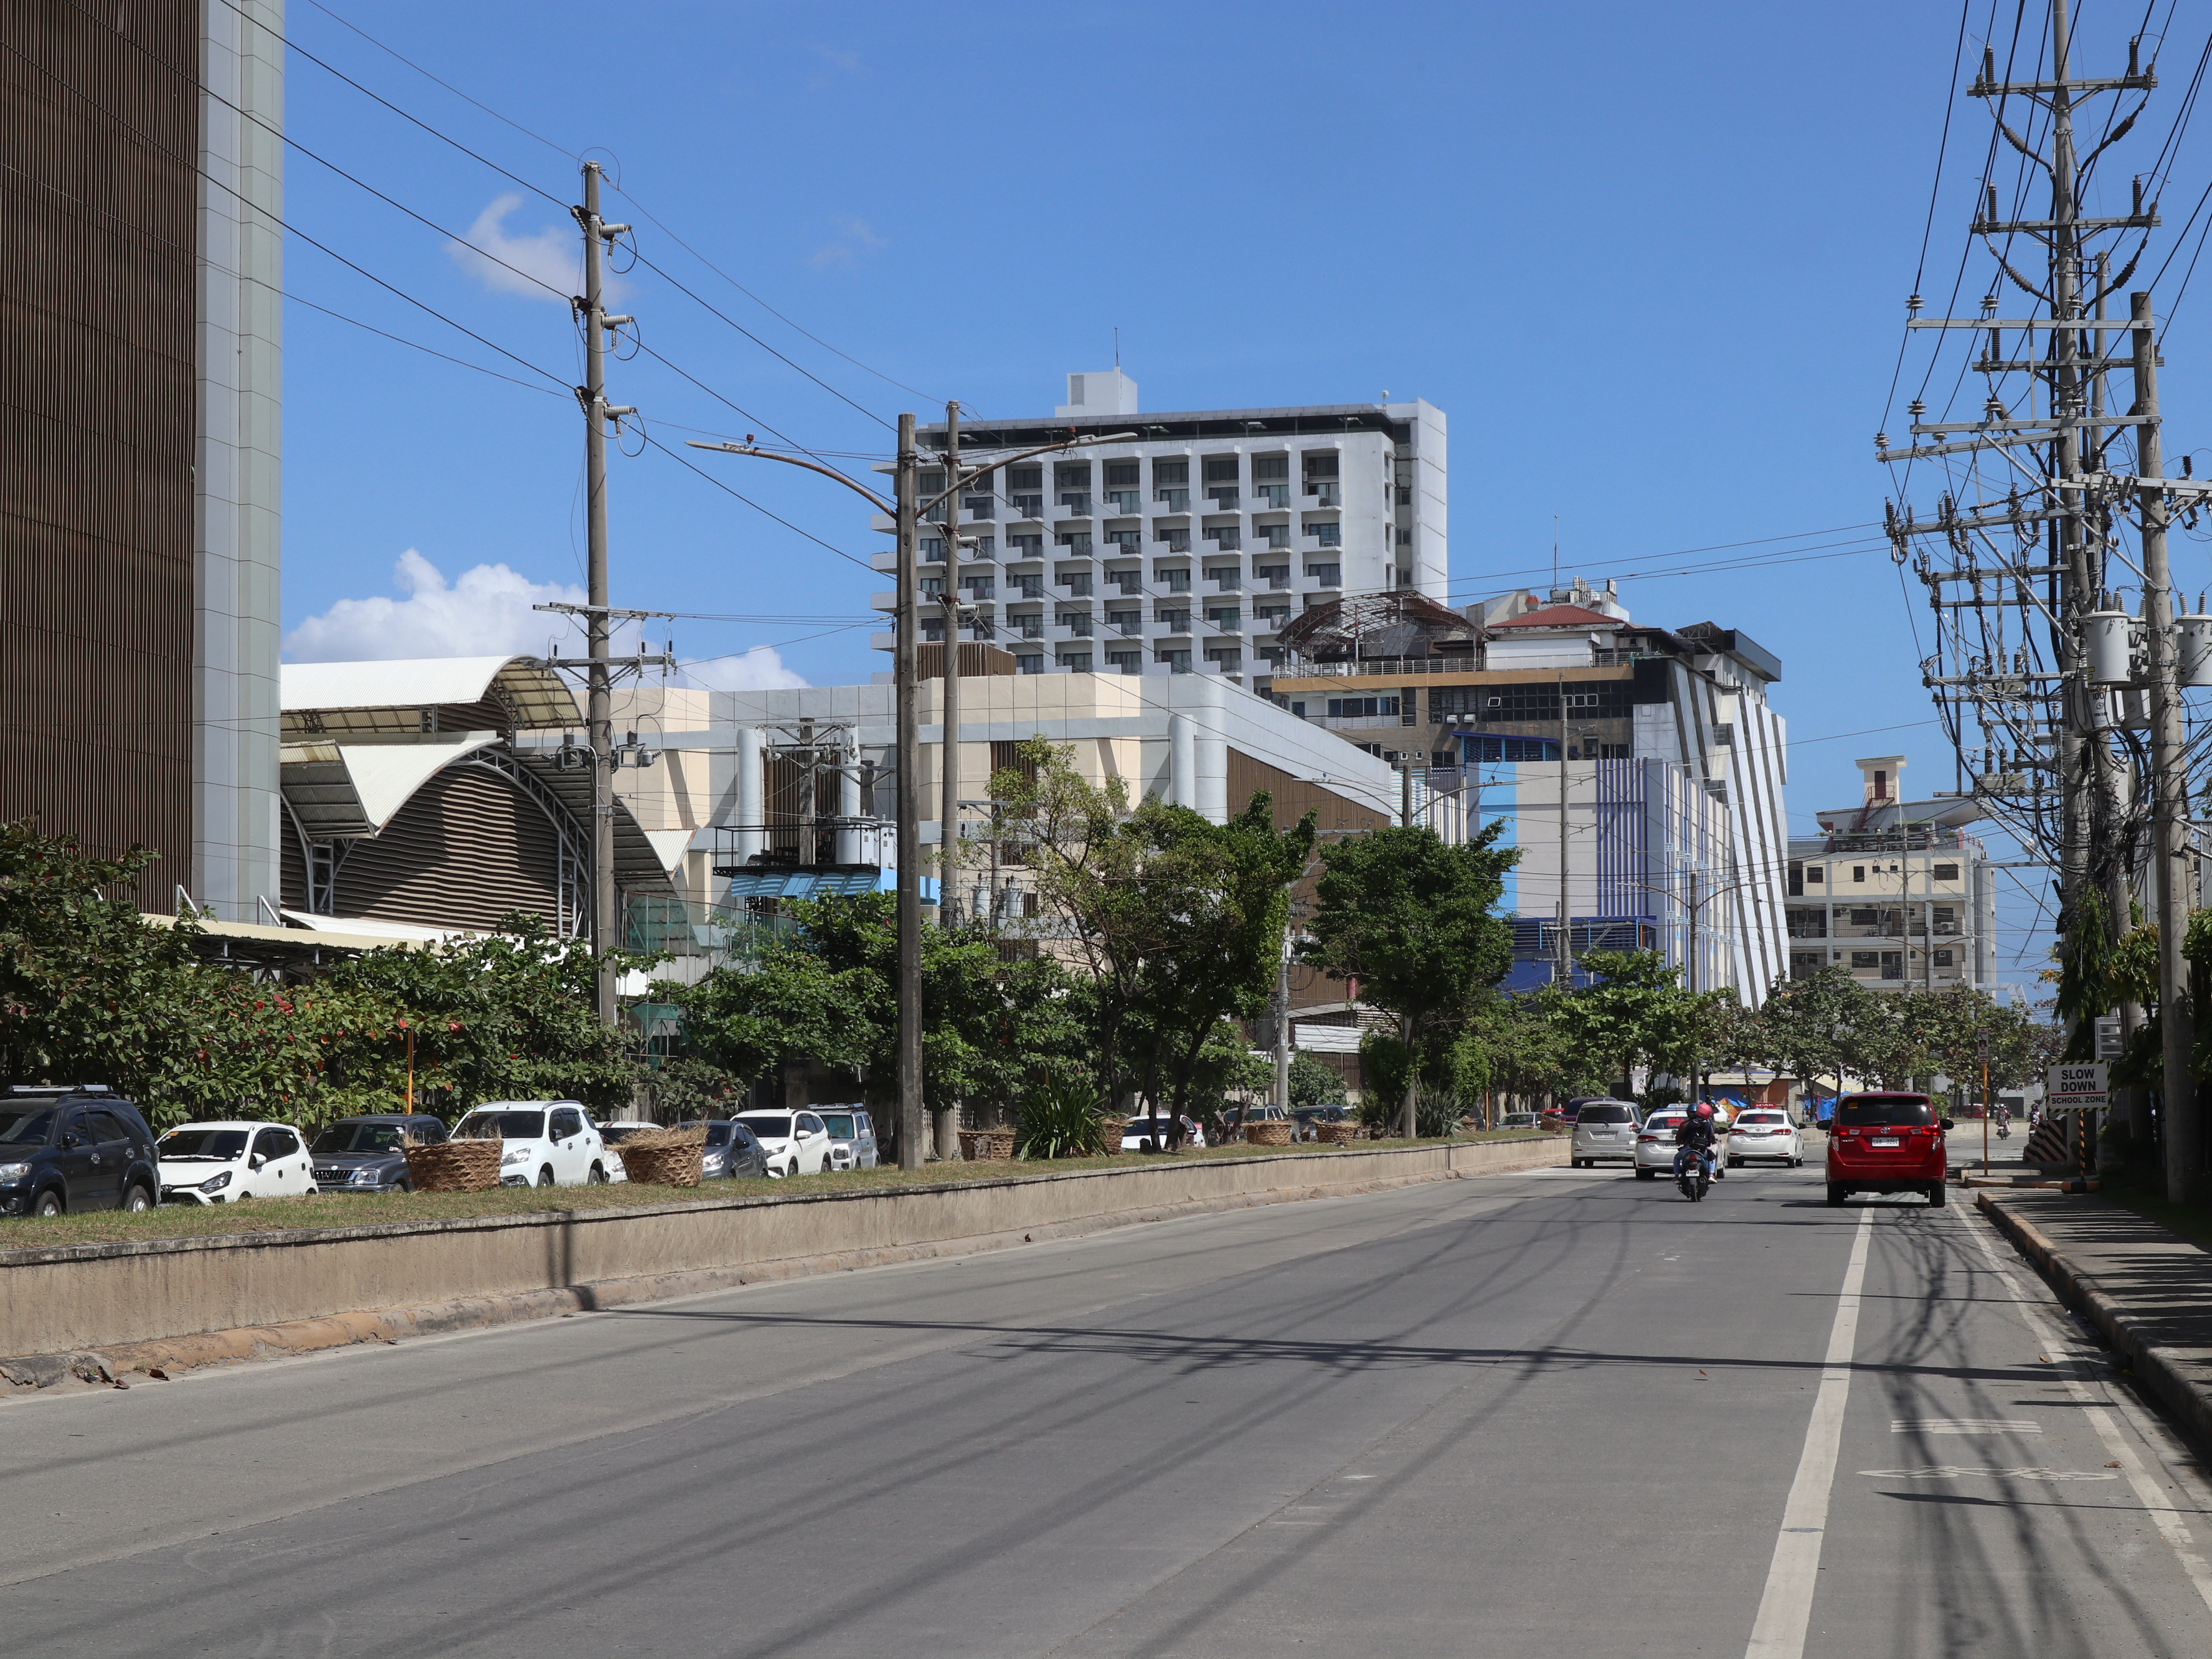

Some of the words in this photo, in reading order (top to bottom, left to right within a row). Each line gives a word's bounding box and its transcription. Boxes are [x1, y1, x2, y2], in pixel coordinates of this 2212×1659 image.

[2092, 692, 2104, 701] 100
[2061, 1069, 2095, 1080] SLOW
[2061, 1081, 2096, 1092] DOWN
